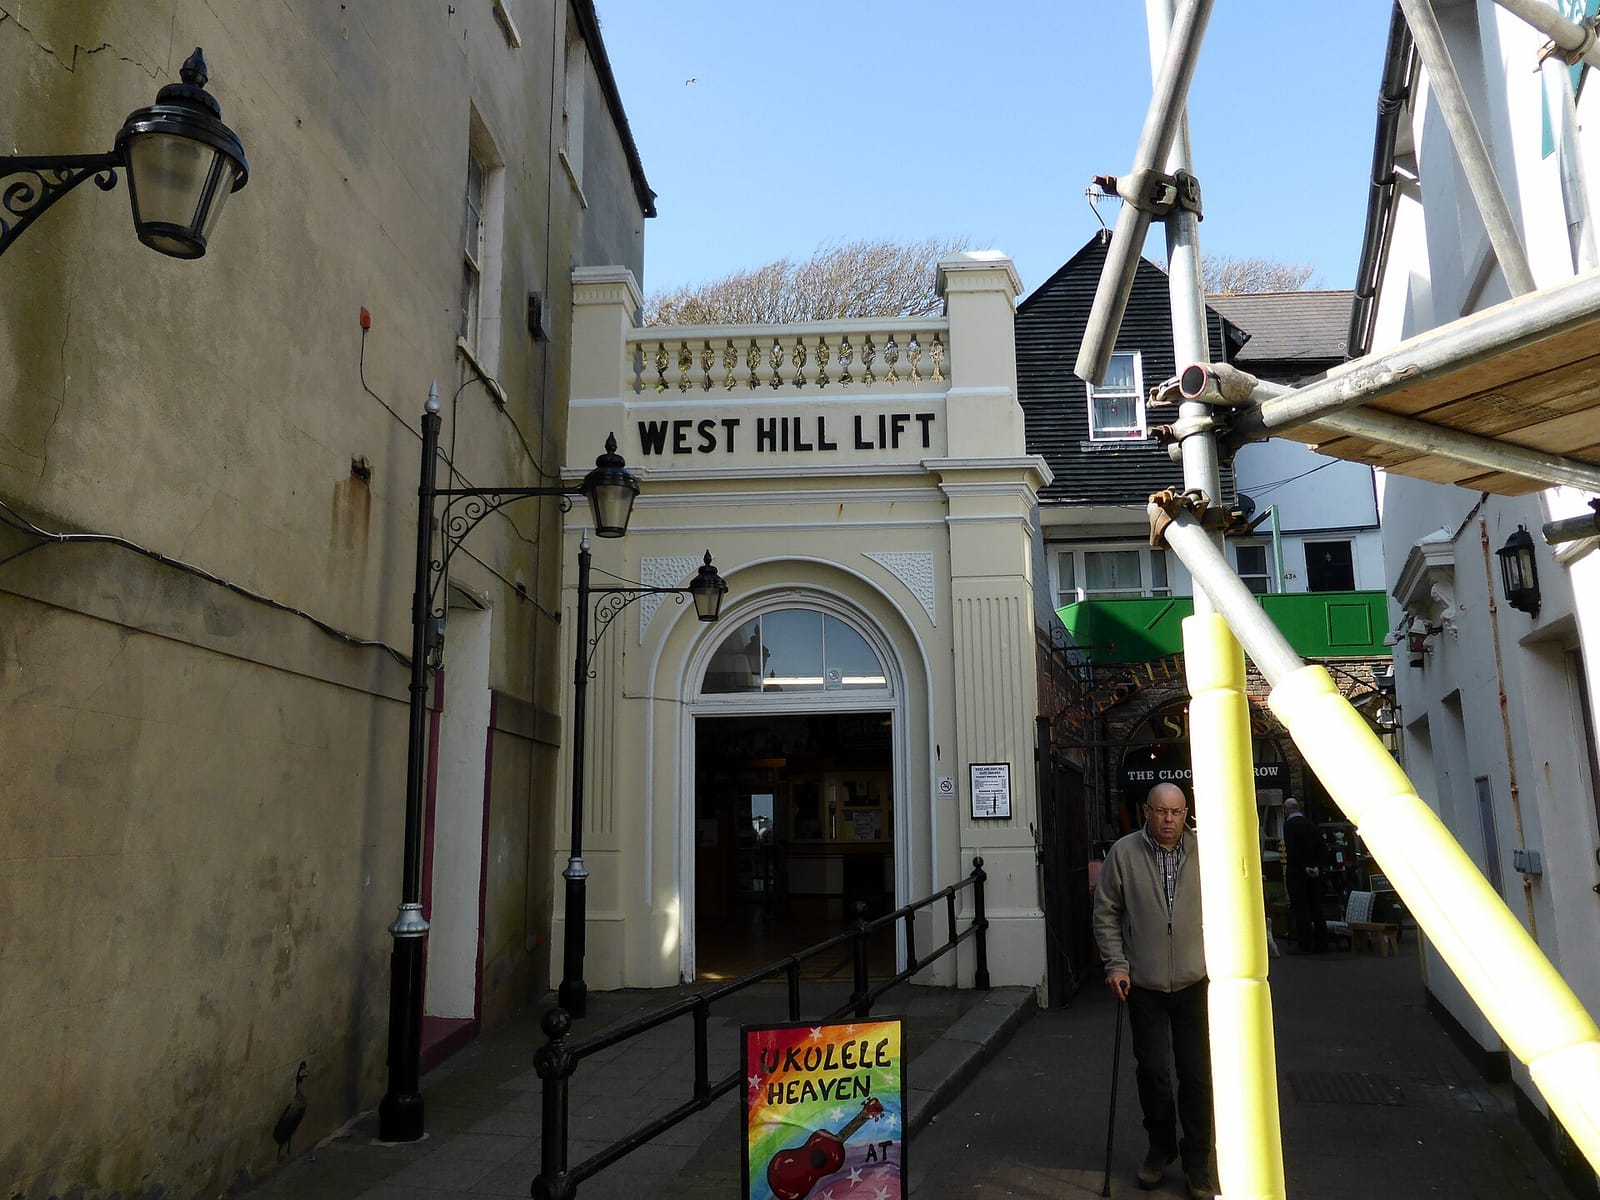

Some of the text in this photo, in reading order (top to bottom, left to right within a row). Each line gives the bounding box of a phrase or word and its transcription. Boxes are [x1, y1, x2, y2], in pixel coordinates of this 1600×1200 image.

[637, 412, 936, 456] WEST HILL LIFT
[1127, 766, 1279, 781] THE CLOC ROW
[759, 1037, 892, 1106] UKULELE HEAVEN
[865, 1140, 893, 1164] AT
